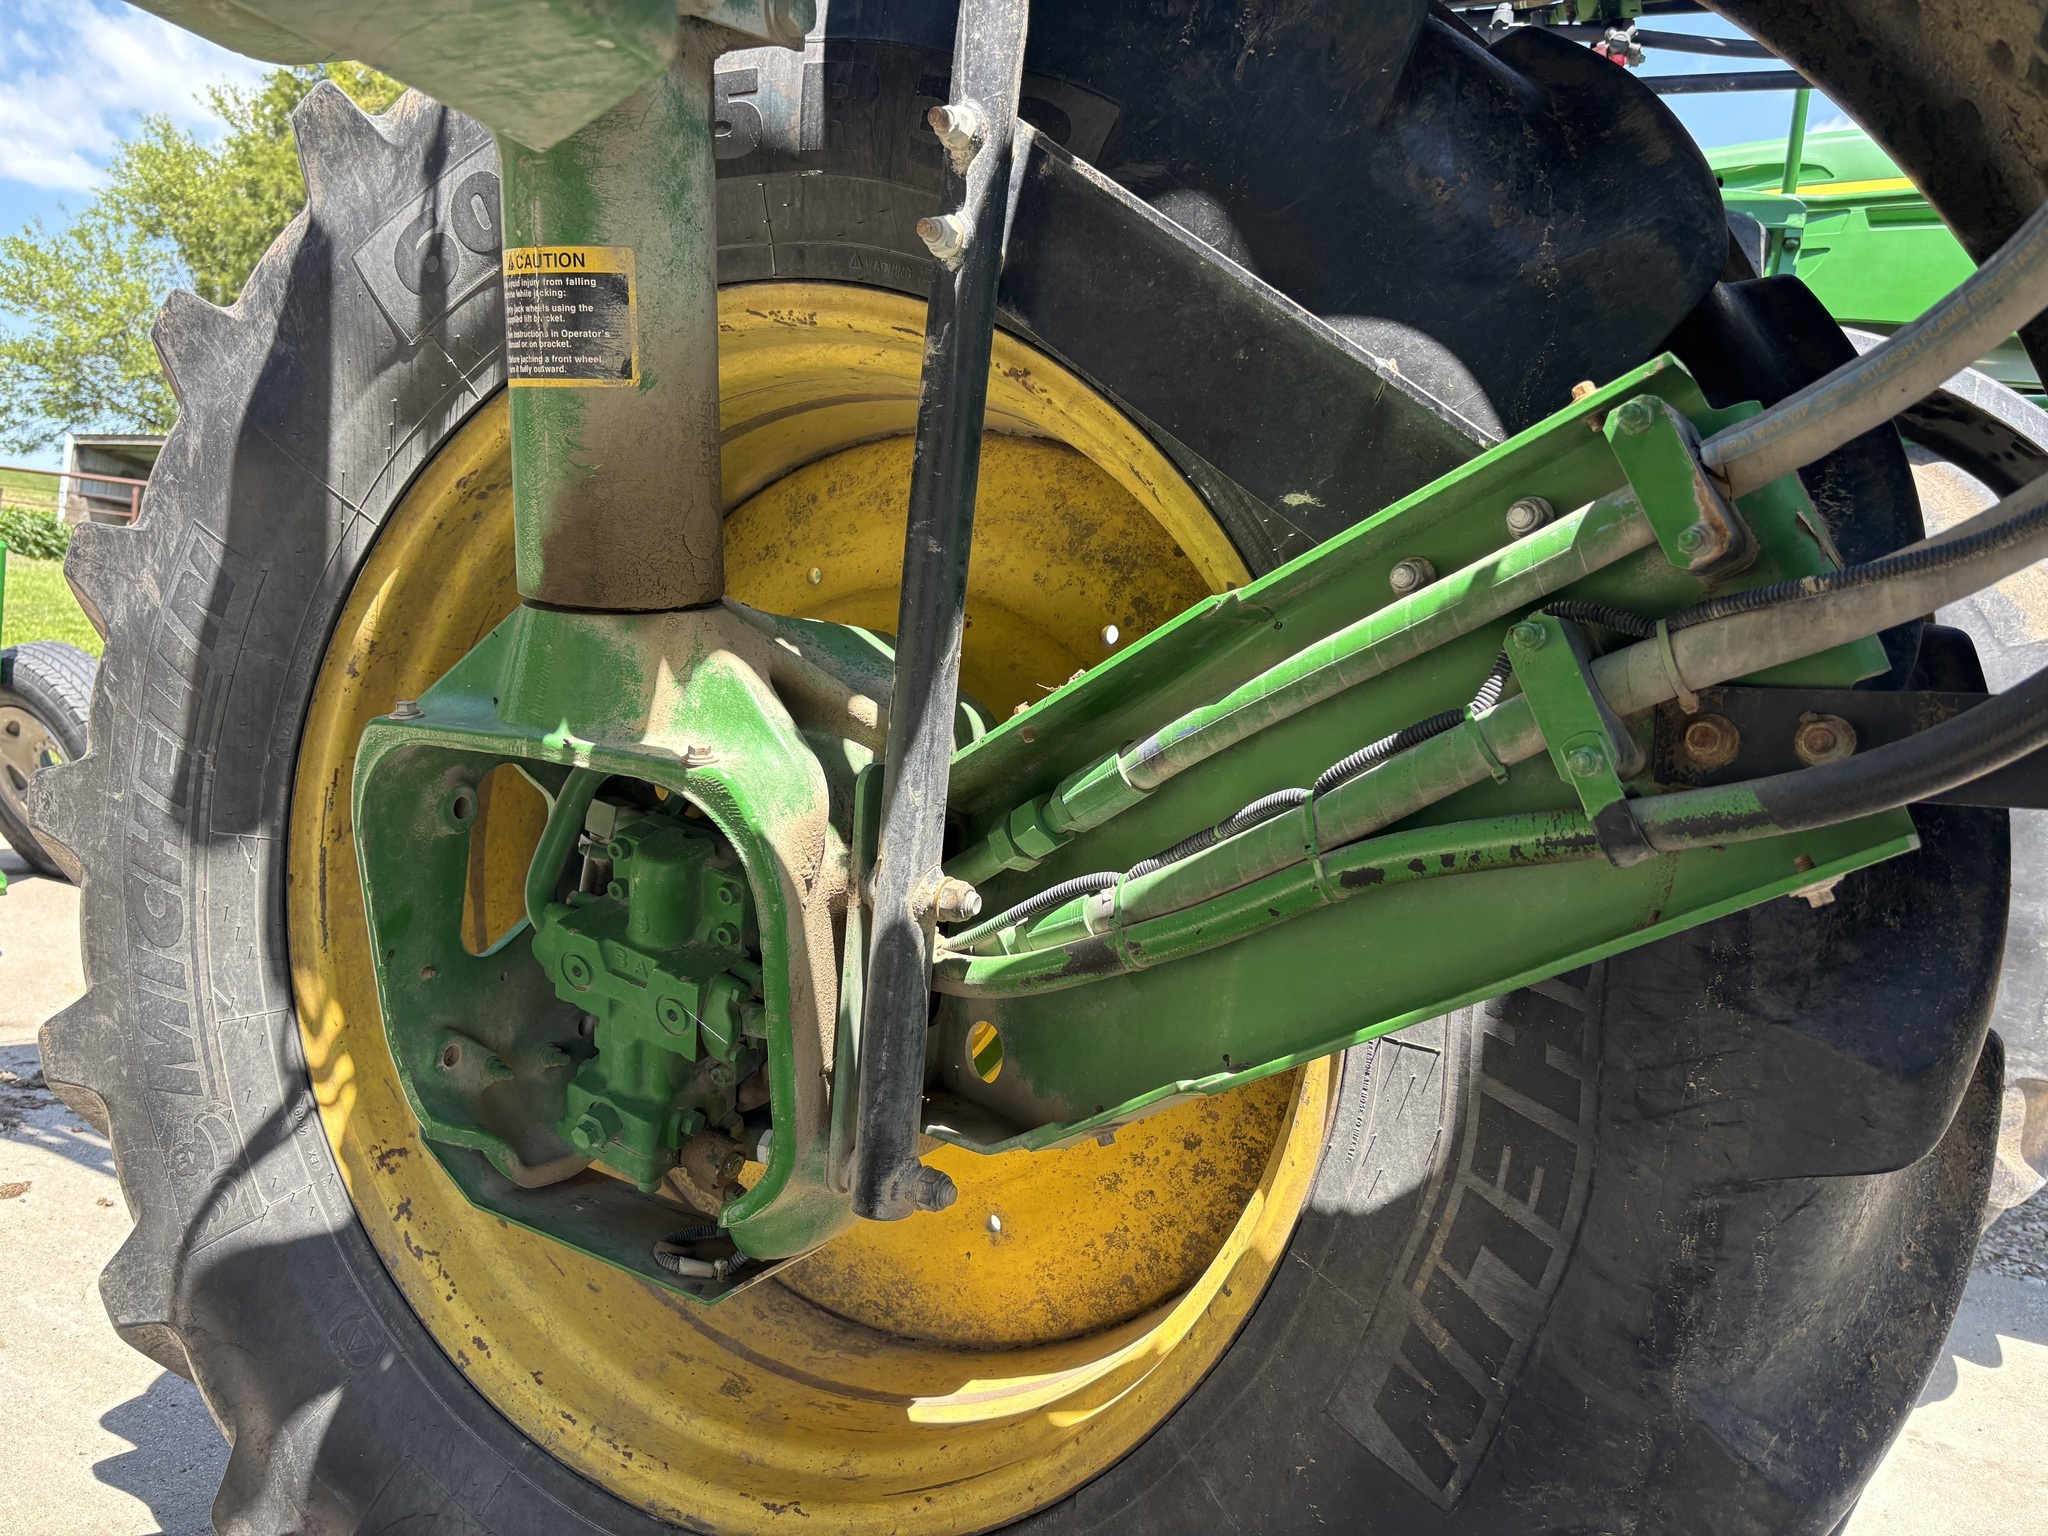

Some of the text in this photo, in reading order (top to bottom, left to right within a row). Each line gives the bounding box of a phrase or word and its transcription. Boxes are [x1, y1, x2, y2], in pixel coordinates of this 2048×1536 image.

[516, 252, 586, 270] CAUTION
[865, 257, 913, 278] WARNING
[521, 278, 540, 289] injury
[543, 277, 563, 286] from
[565, 277, 597, 288] falling
[525, 303, 550, 312] wheels
[551, 304, 577, 313] using
[578, 303, 594, 312] the
[550, 329, 559, 338] in
[561, 329, 610, 339] Operator's
[539, 339, 572, 349] bracket.
[551, 355, 573, 363] front
[574, 354, 602, 363] wheel
[533, 365, 567, 374] outward.
[1753, 415, 1786, 440] MAX
[1787, 403, 1810, 423] WP
[1919, 303, 1971, 345] FLAME
[274, 700, 299, 758] RADIAL
[293, 600, 330, 683] TUBELESS
[129, 534, 236, 1098] MICHELIN
